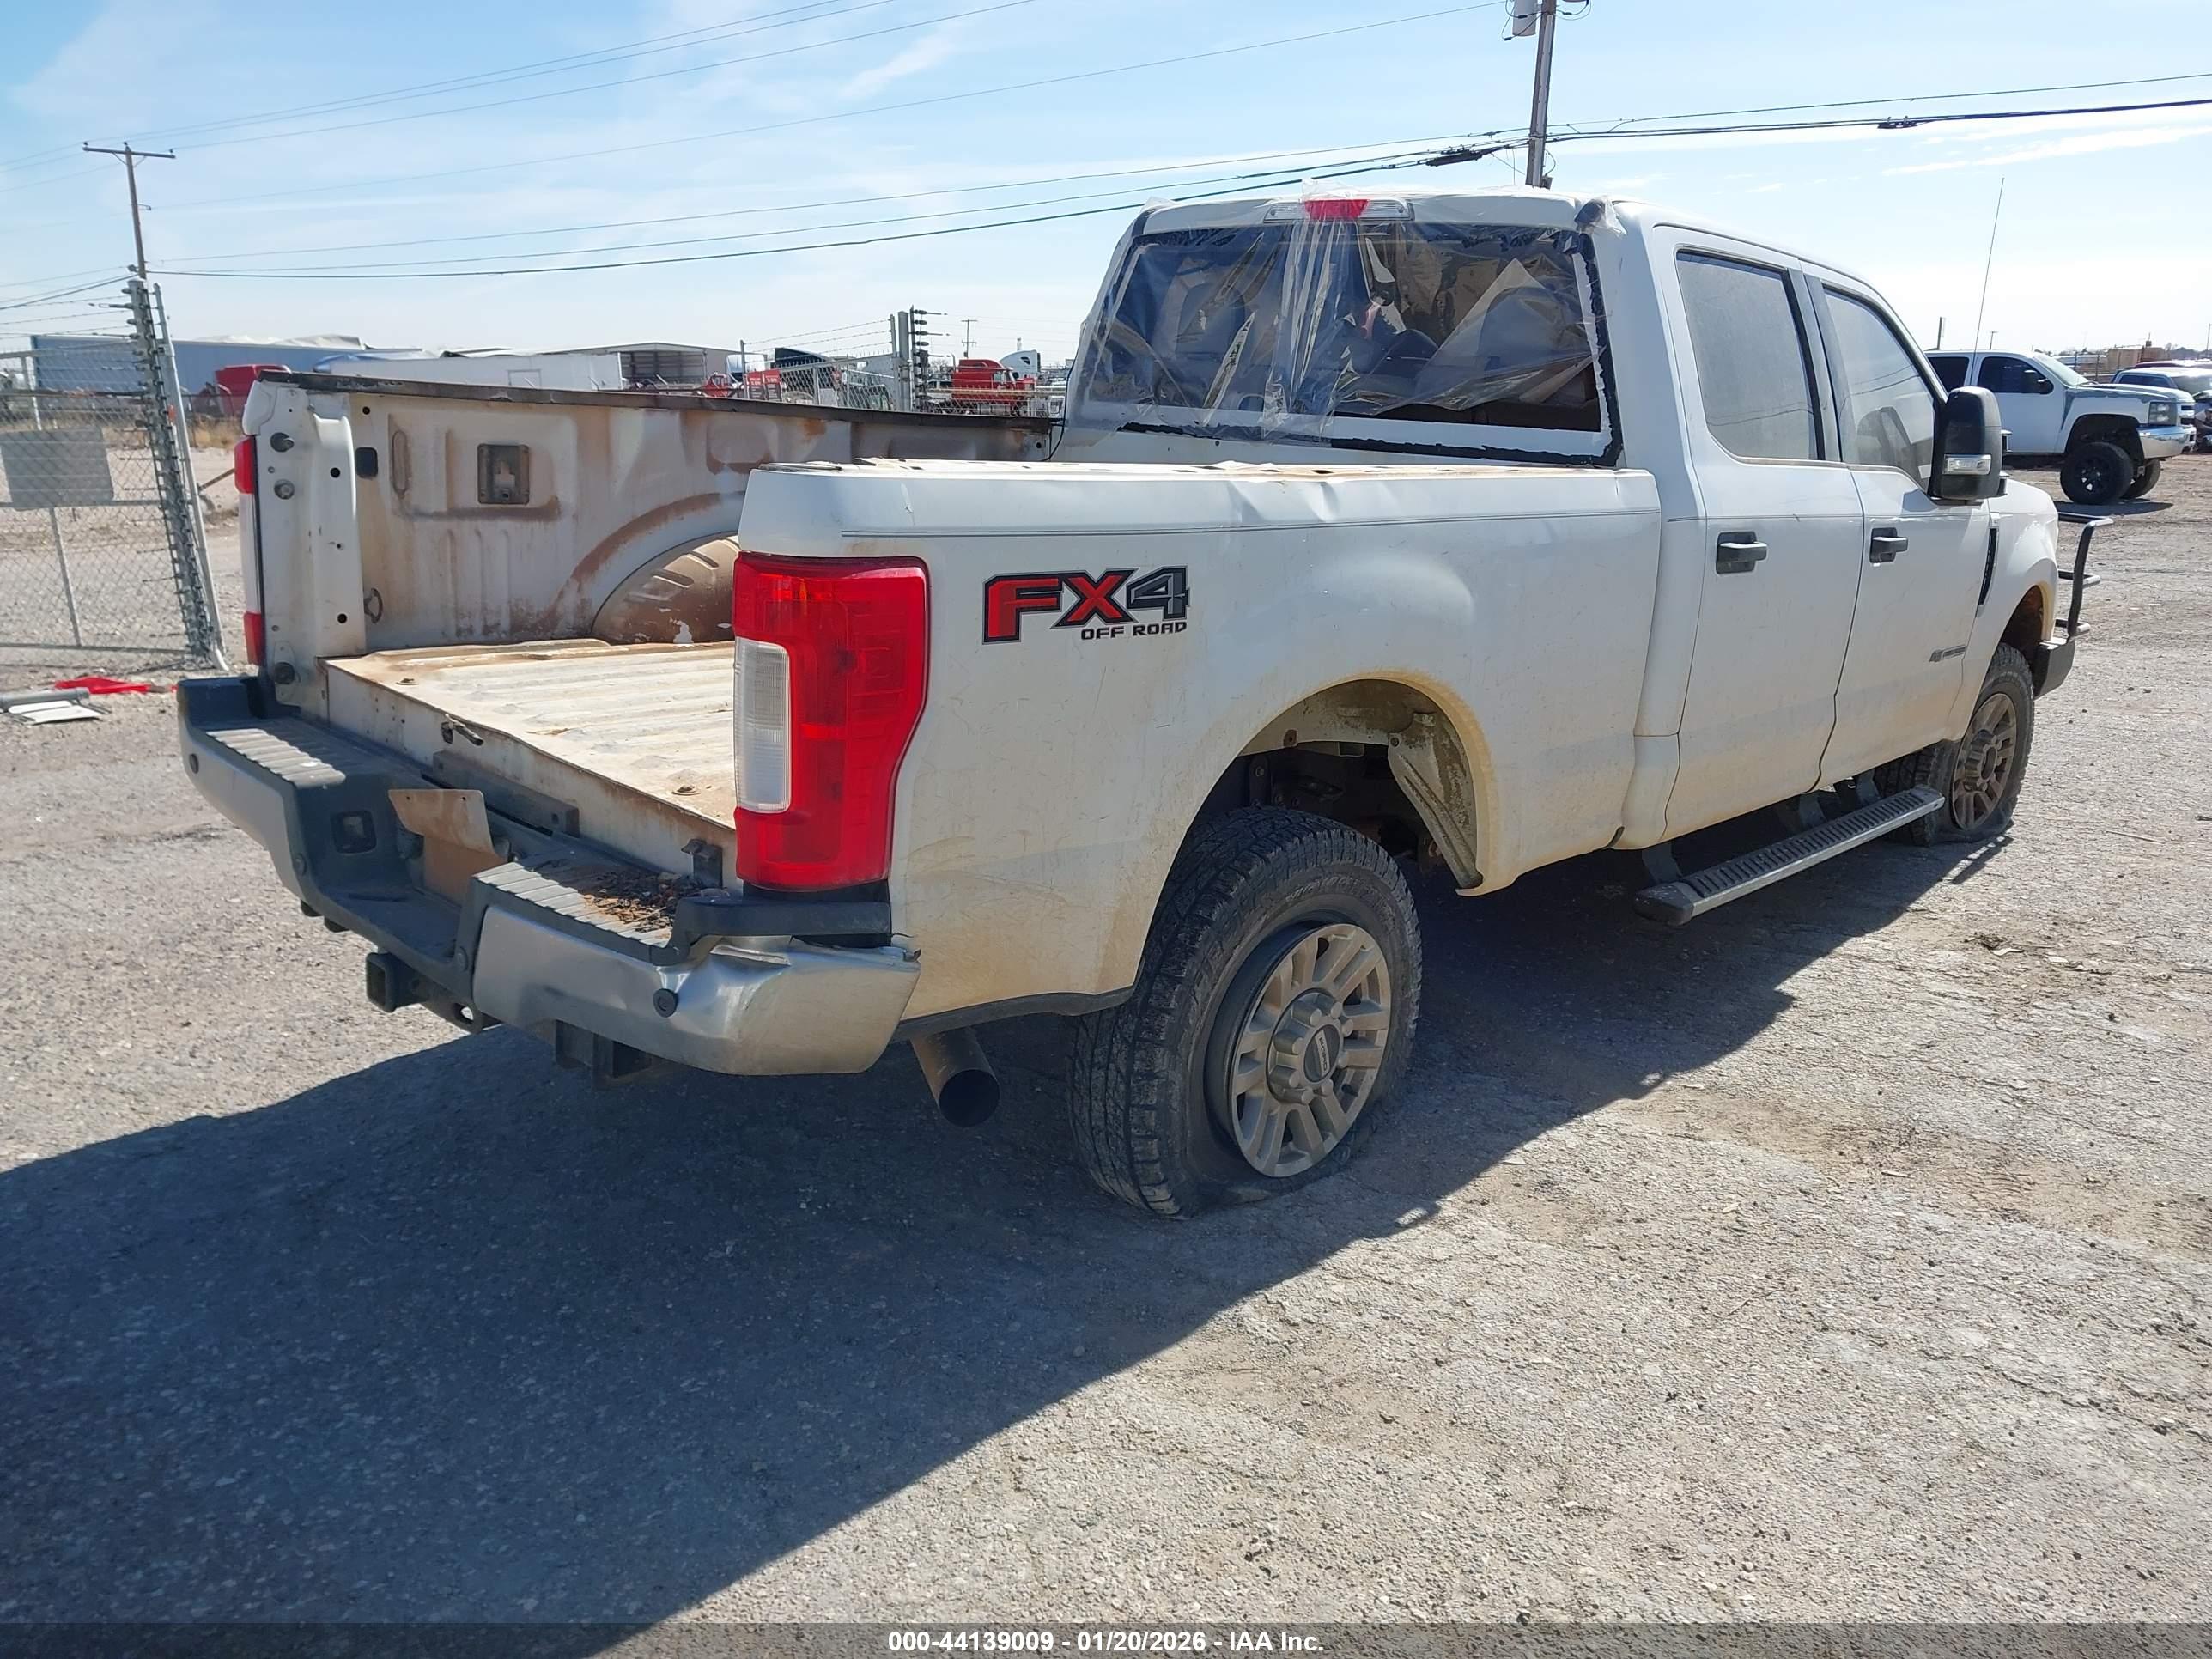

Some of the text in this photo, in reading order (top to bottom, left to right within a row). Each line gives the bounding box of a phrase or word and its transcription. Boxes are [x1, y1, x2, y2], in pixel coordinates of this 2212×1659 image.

[982, 565, 1190, 645] FX4
[1080, 621, 1188, 641] OFF ROAD
